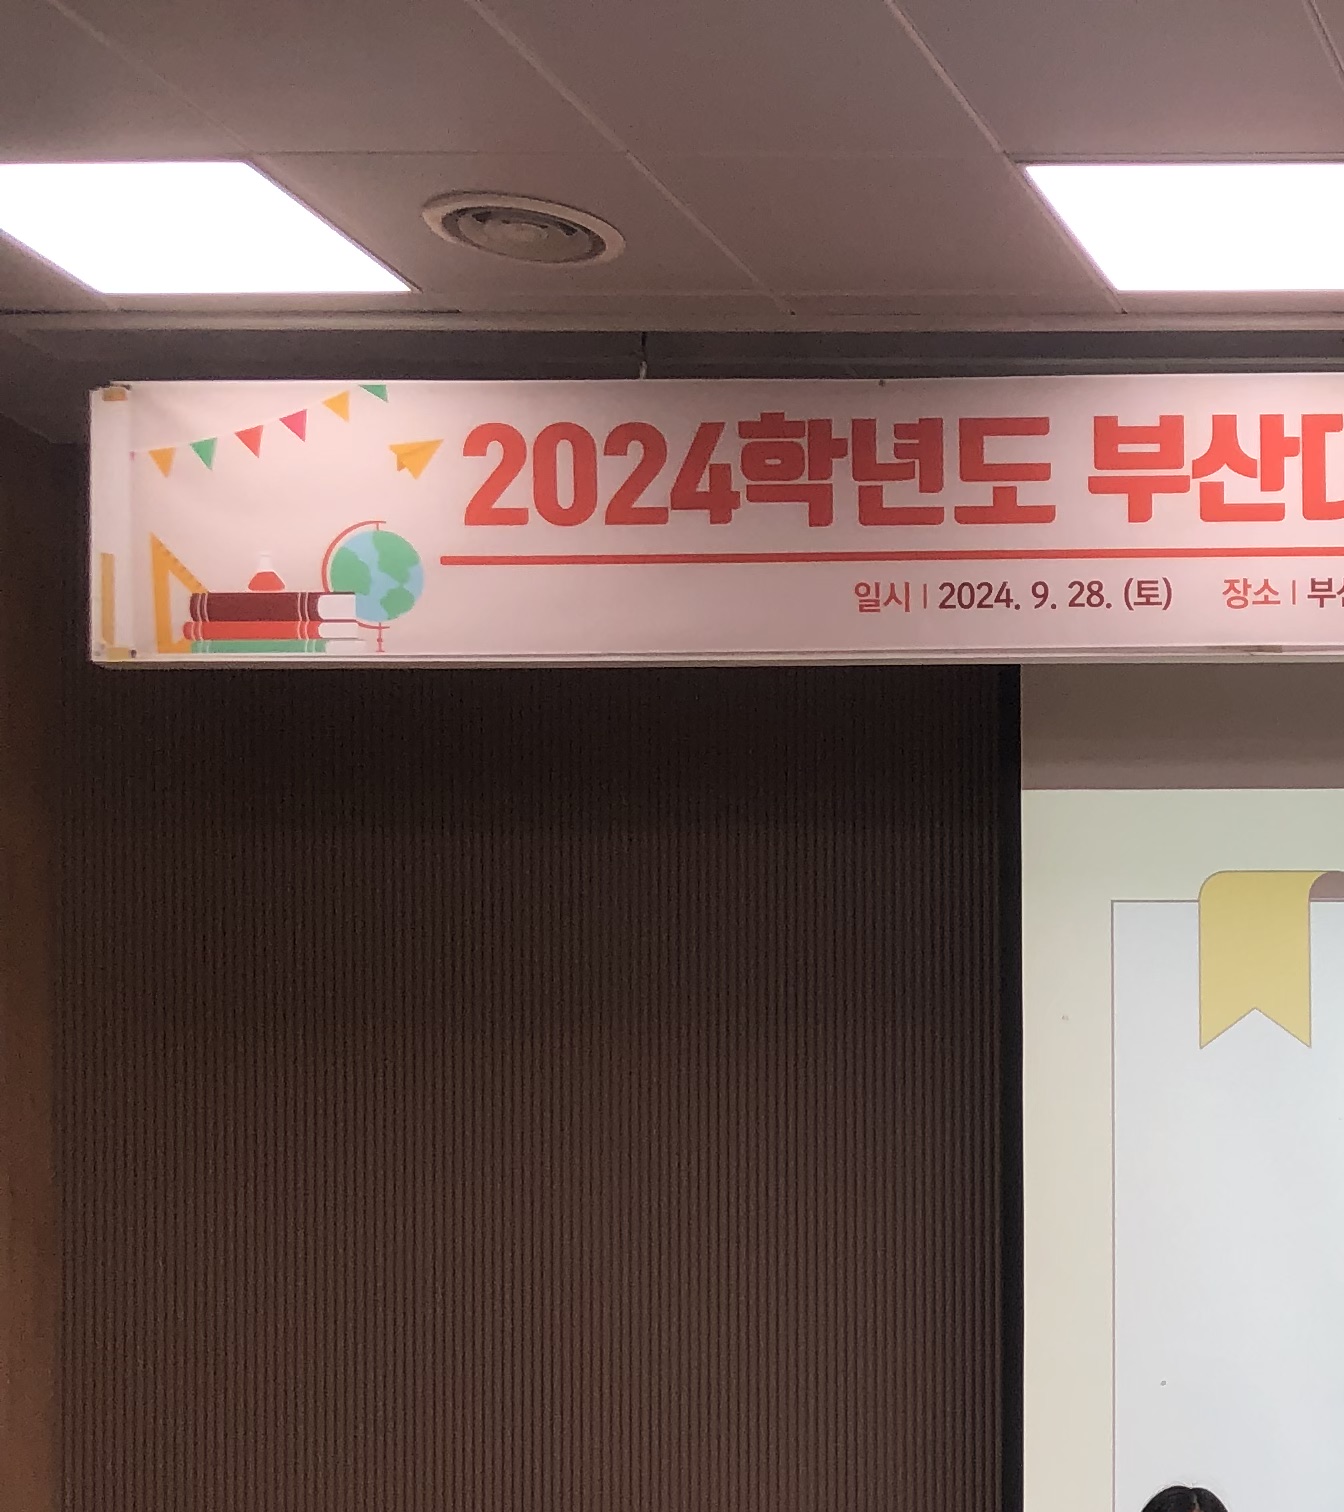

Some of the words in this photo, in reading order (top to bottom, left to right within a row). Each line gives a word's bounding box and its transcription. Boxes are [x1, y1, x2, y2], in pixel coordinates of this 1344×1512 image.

[462, 411, 1057, 527] 2024학년도
[854, 580, 911, 614] 일시
[938, 582, 1022, 611] 2024.
[1032, 582, 1058, 610] 9.
[1068, 580, 1114, 609] 28.
[1123, 576, 1174, 612] (토)
[1222, 576, 1281, 610] 장소
